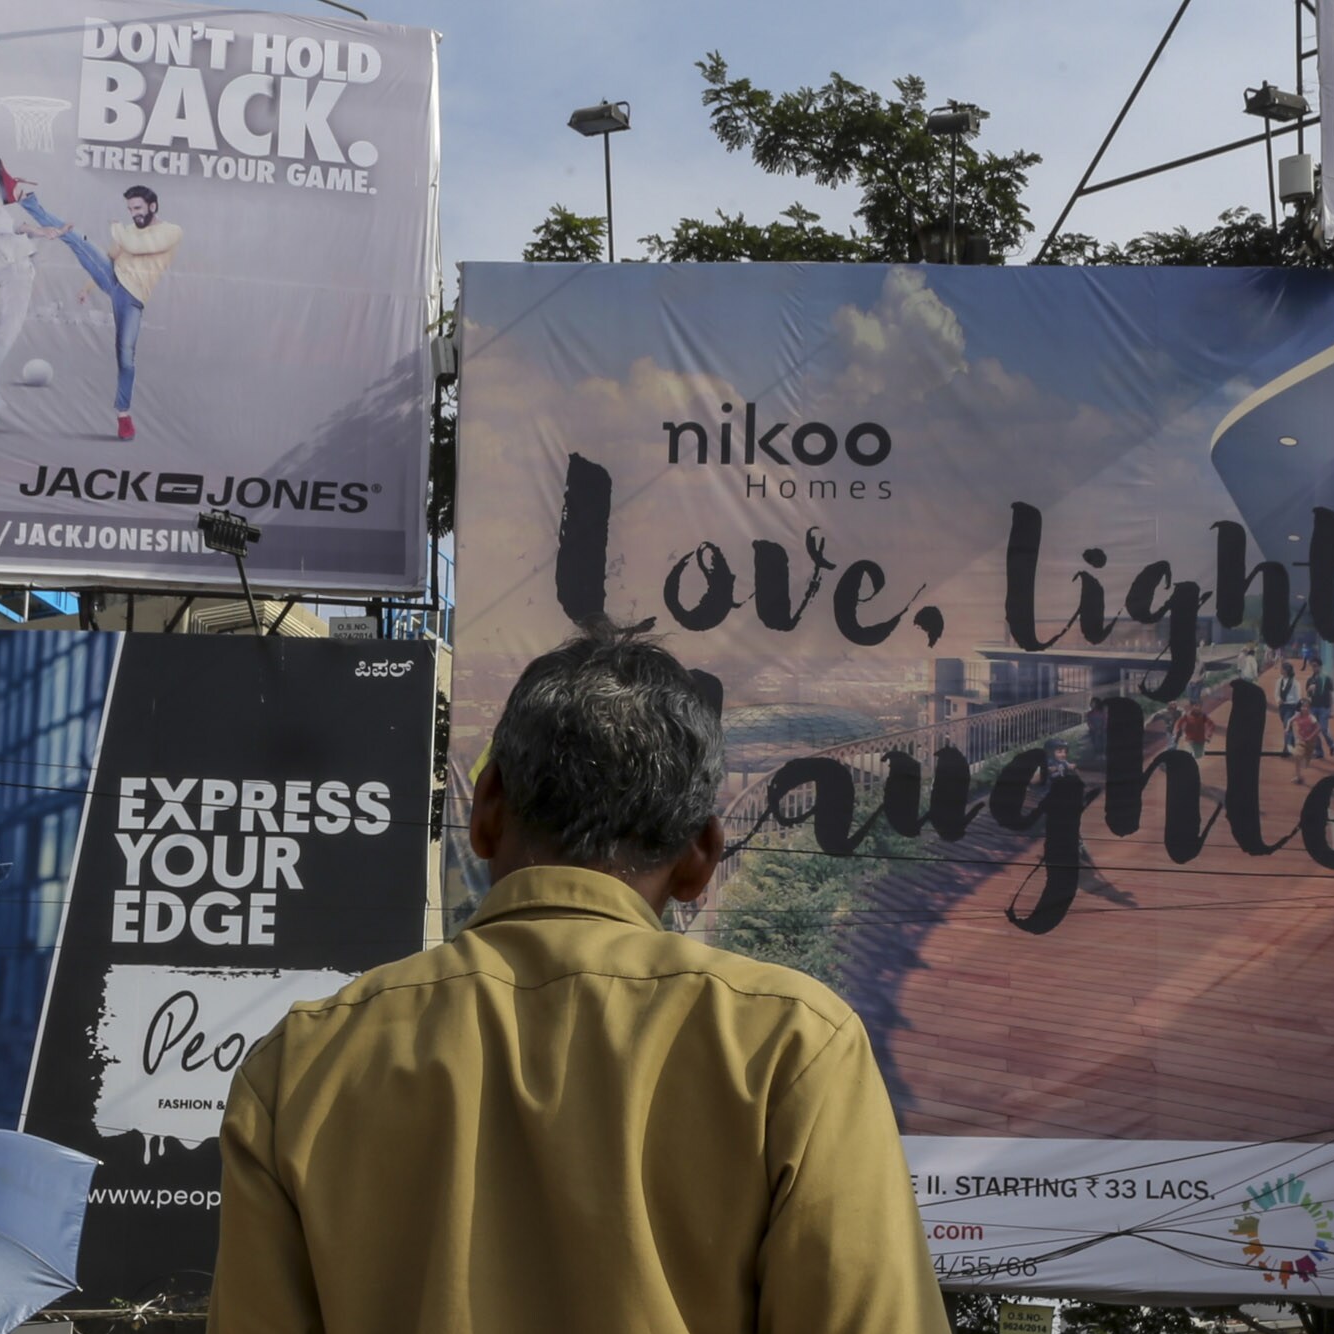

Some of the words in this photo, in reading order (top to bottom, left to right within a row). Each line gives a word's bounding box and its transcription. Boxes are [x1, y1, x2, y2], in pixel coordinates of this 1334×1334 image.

[83, 17, 235, 70] DON'T
[252, 32, 381, 84] HOLD
[77, 58, 379, 167] BACK.
[74, 144, 190, 176] STRETCH
[199, 154, 275, 184] YOUR
[287, 163, 378, 195] GAME.
[662, 402, 892, 467] nikoo
[19, 465, 155, 502] JACK
[745, 473, 893, 500] Homes
[118, 777, 391, 836] EXPRESS
[114, 833, 304, 889] YOUR
[111, 889, 277, 946] EDGE
[143, 990, 259, 1076] Peo
[158, 1099, 213, 1110] FASHION
[955, 1176, 1078, 1198] STARTING
[1146, 1180, 1216, 1201] LACS.
[927, 1222, 984, 1241] .com
